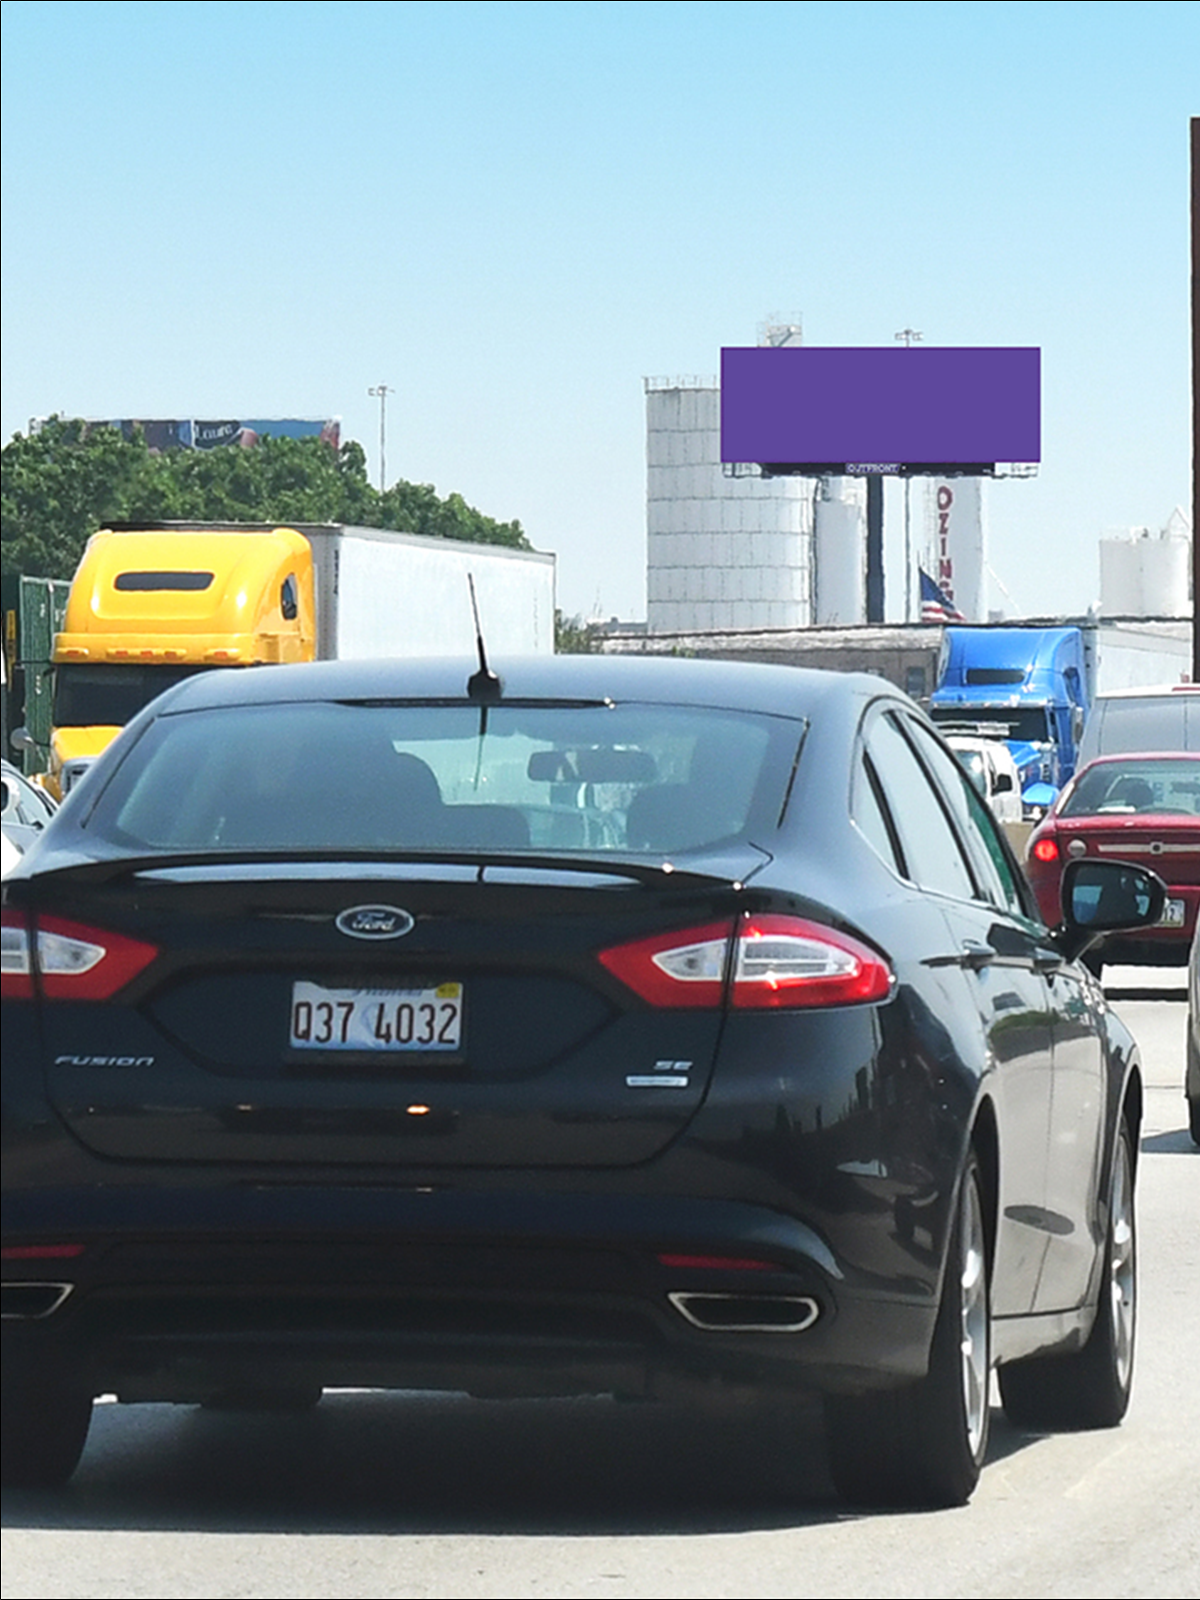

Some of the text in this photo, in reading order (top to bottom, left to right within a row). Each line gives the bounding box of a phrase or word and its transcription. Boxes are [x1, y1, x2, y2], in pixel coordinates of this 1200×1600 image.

[351, 912, 396, 931] Ford
[293, 1001, 458, 1045] Q37 4032
[54, 1055, 154, 1067] FUSION
[653, 1060, 693, 1071] SE
